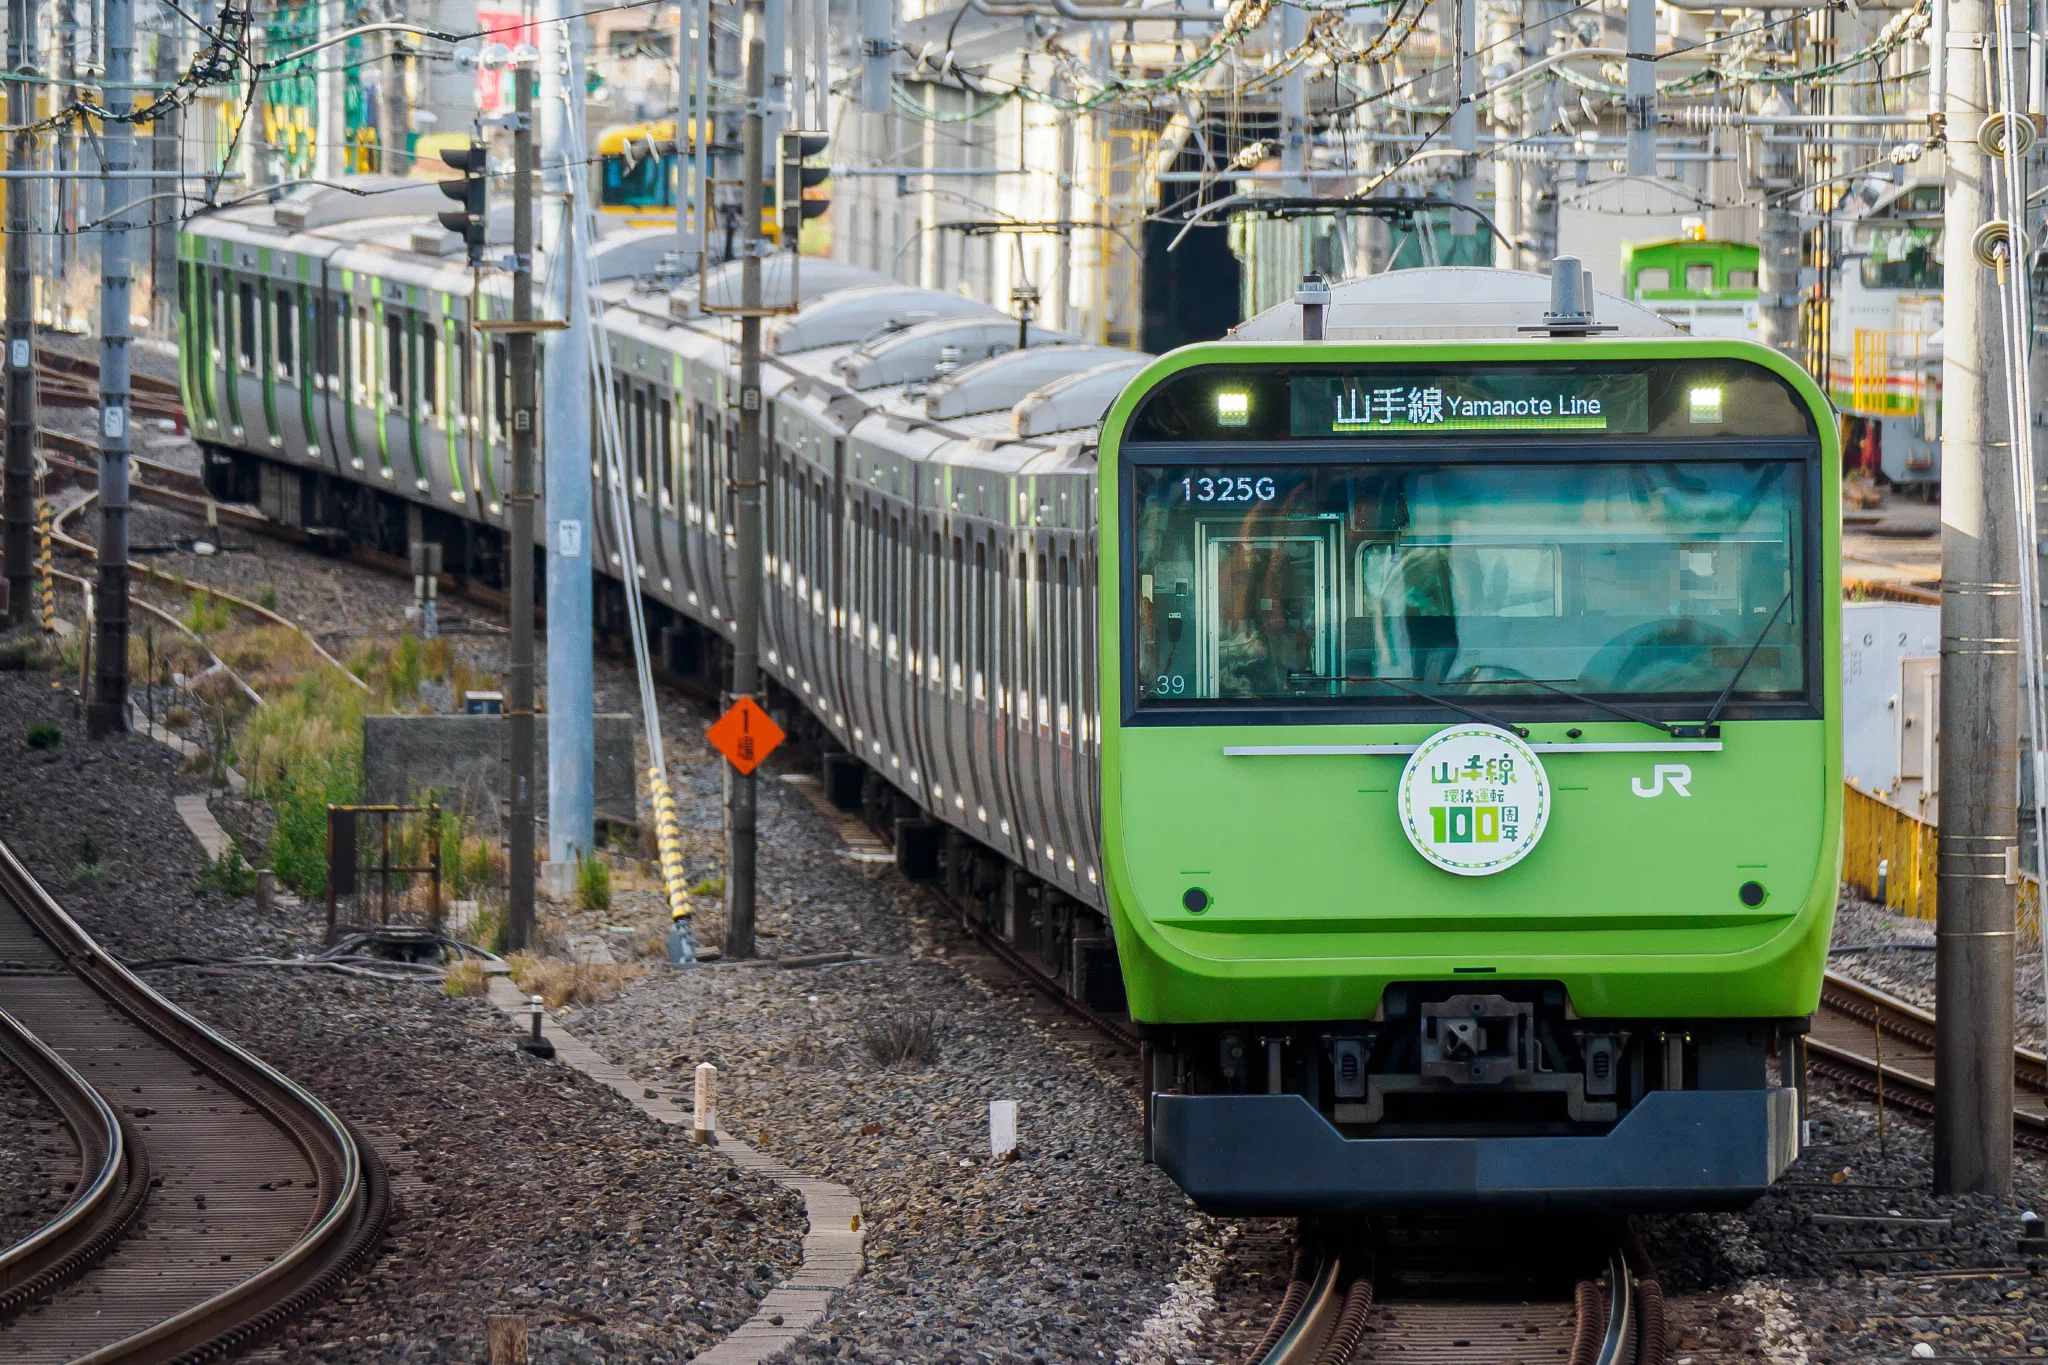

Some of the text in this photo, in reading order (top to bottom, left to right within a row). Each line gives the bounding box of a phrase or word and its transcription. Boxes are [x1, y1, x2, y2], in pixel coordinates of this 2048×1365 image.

[1337, 387, 1601, 424] 山手線 Yamanote Line
[1181, 476, 1276, 502] 1325G
[1156, 675, 1185, 695] 39
[1431, 752, 1518, 785] 山手線
[1631, 764, 1692, 798] JR
